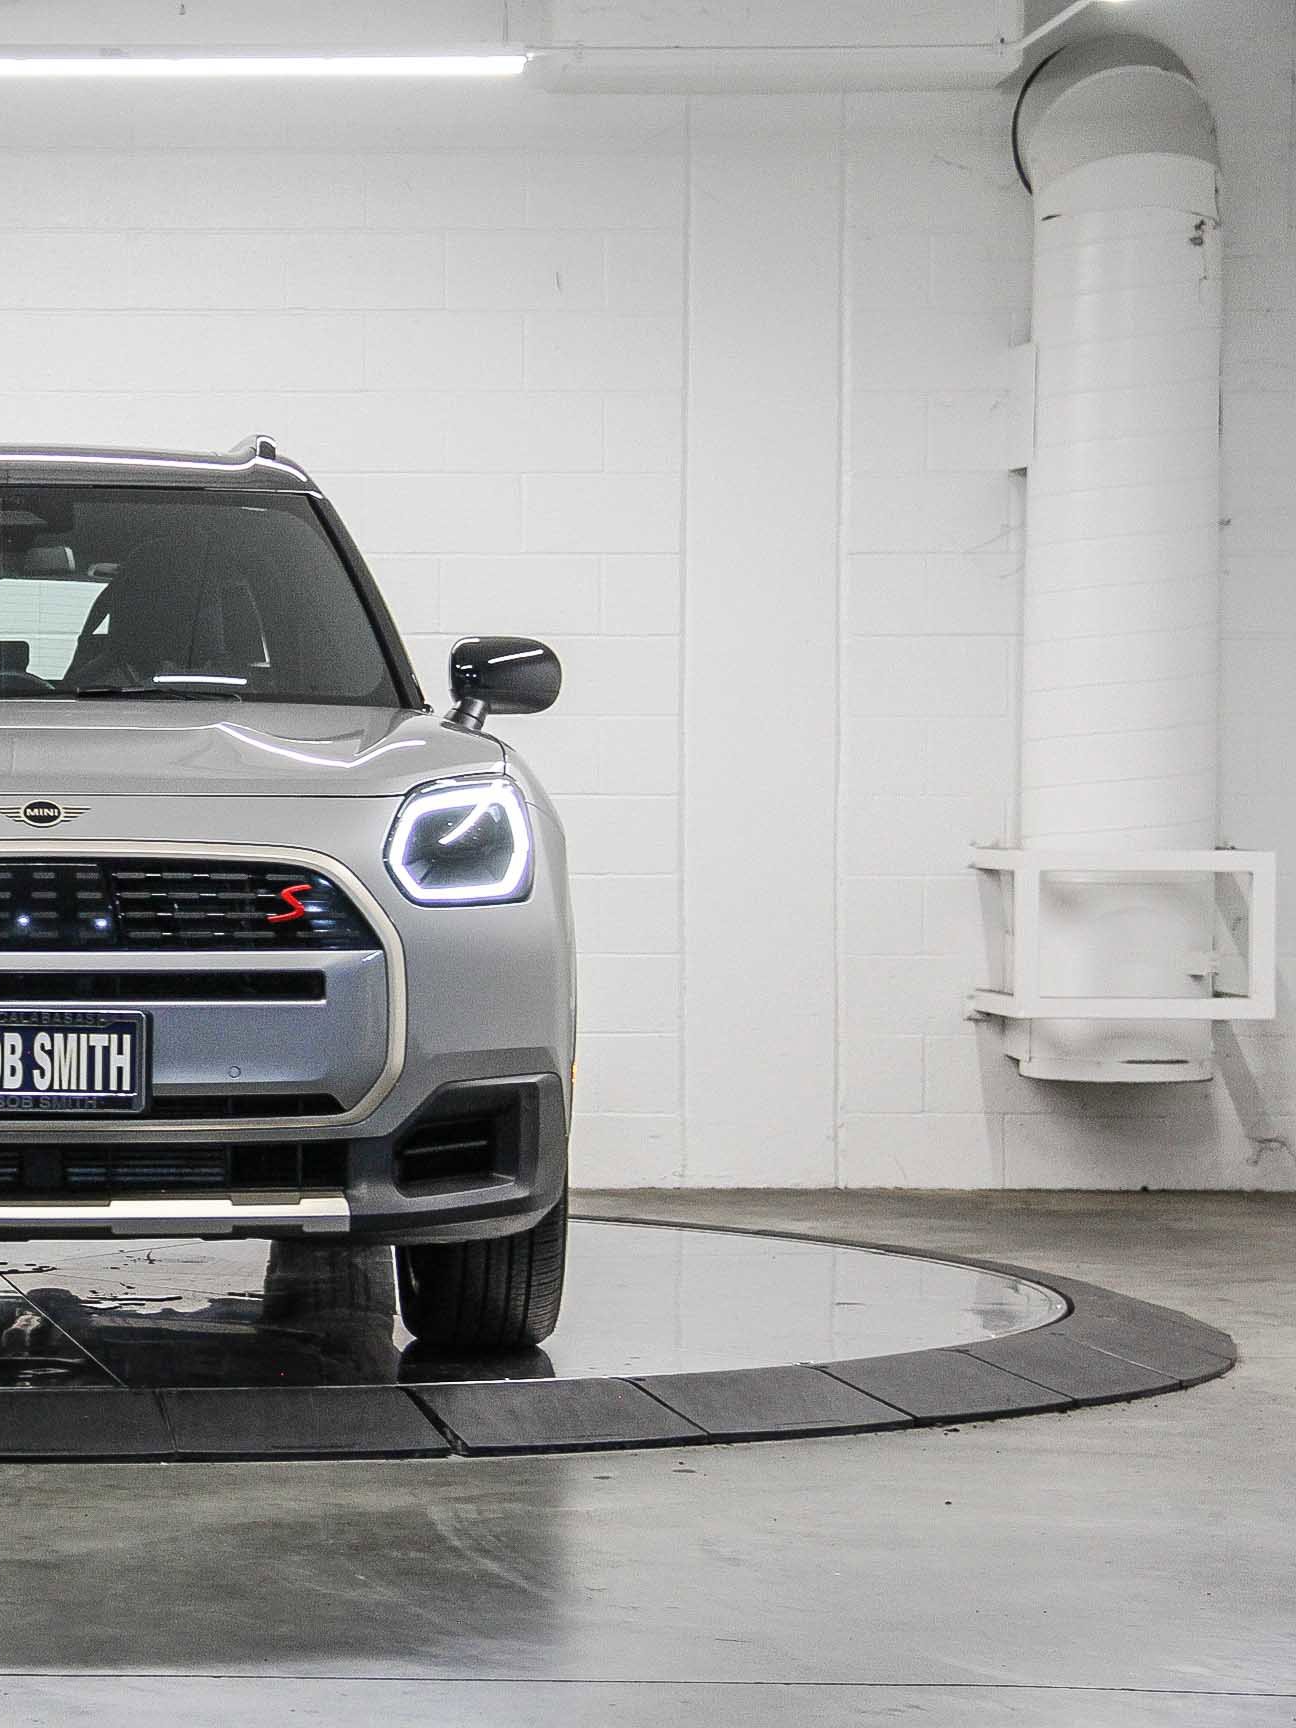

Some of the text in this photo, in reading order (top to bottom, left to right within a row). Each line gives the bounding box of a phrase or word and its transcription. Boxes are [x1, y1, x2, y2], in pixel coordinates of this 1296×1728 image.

[25, 808, 59, 817] MINI
[266, 884, 313, 924] S
[32, 1031, 131, 1091] SMITH
[39, 1096, 97, 1109] SMITH
